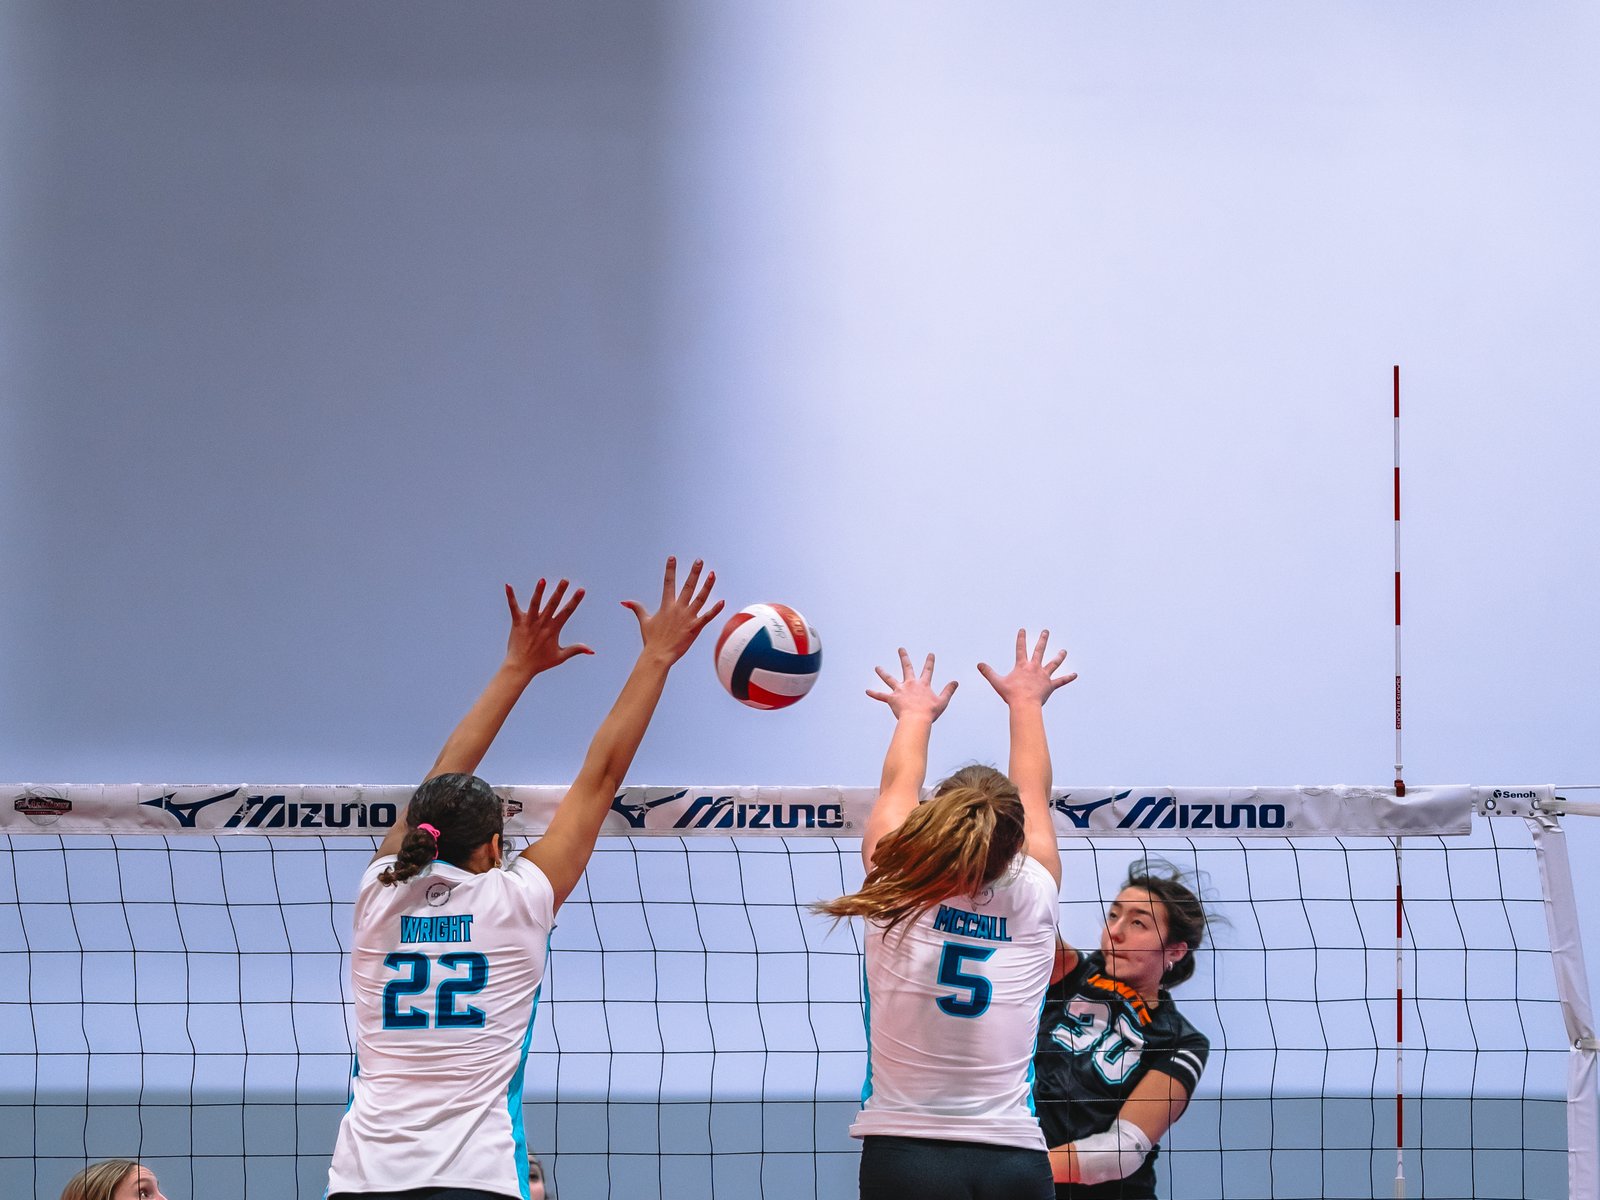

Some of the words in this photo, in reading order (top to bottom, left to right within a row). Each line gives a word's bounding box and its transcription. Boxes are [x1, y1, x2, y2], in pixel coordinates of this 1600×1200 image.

[401, 915, 473, 943] WRIGHT
[933, 904, 1012, 942] MCCALL
[382, 951, 489, 1030] 22
[935, 941, 997, 1018] 5
[1052, 993, 1146, 1085] 30
